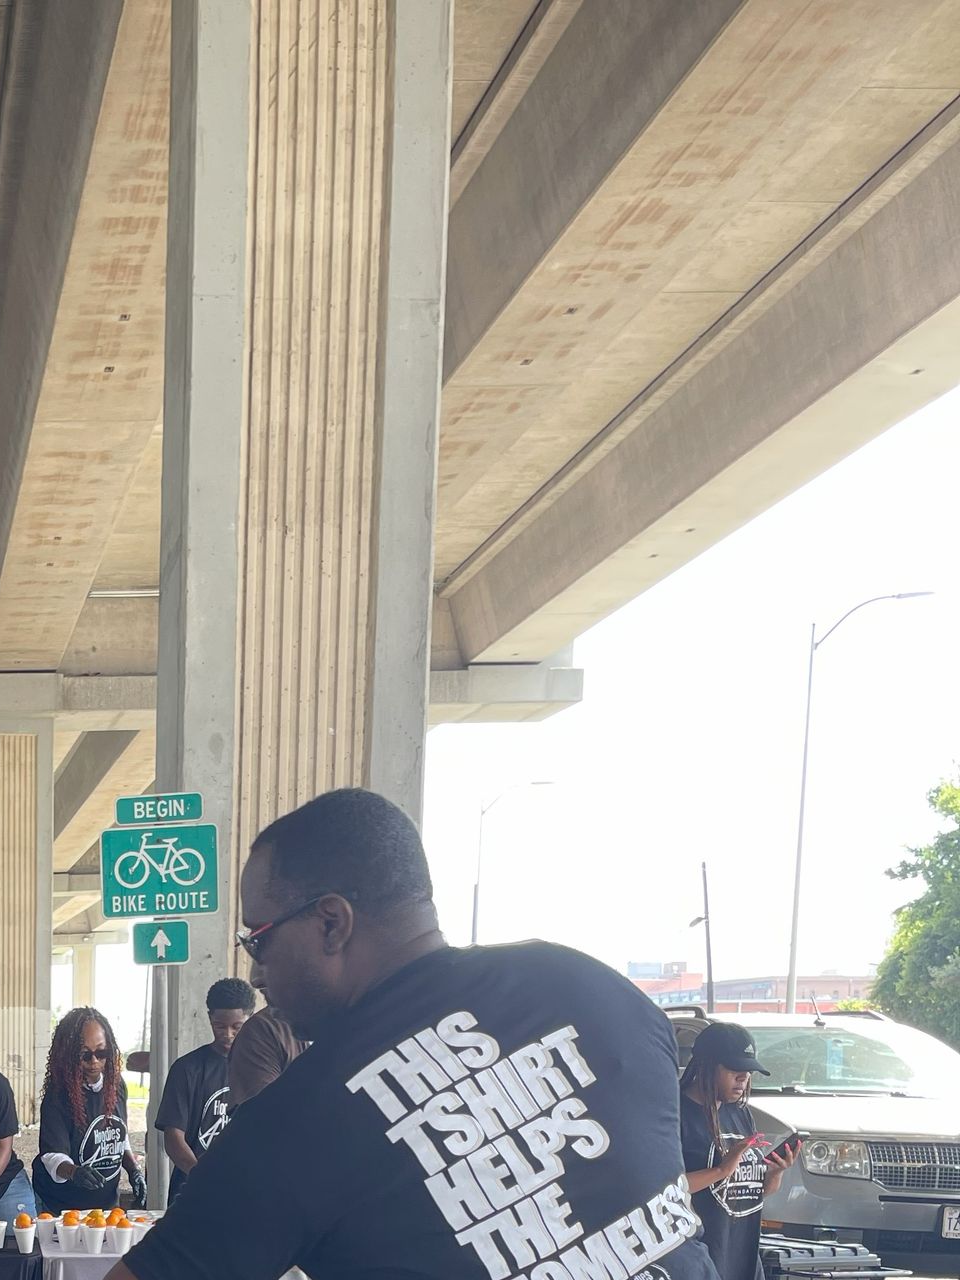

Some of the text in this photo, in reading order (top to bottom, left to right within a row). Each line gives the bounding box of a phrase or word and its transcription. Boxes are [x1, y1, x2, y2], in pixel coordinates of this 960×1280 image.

[133, 799, 184, 819] BEGIN
[111, 891, 209, 913] BIKE ROUTE
[345, 1010, 500, 1123] THIS
[385, 1024, 597, 1177] TSHIRT
[93, 1126, 121, 1145] Hoodies
[424, 1097, 610, 1233] HELPS
